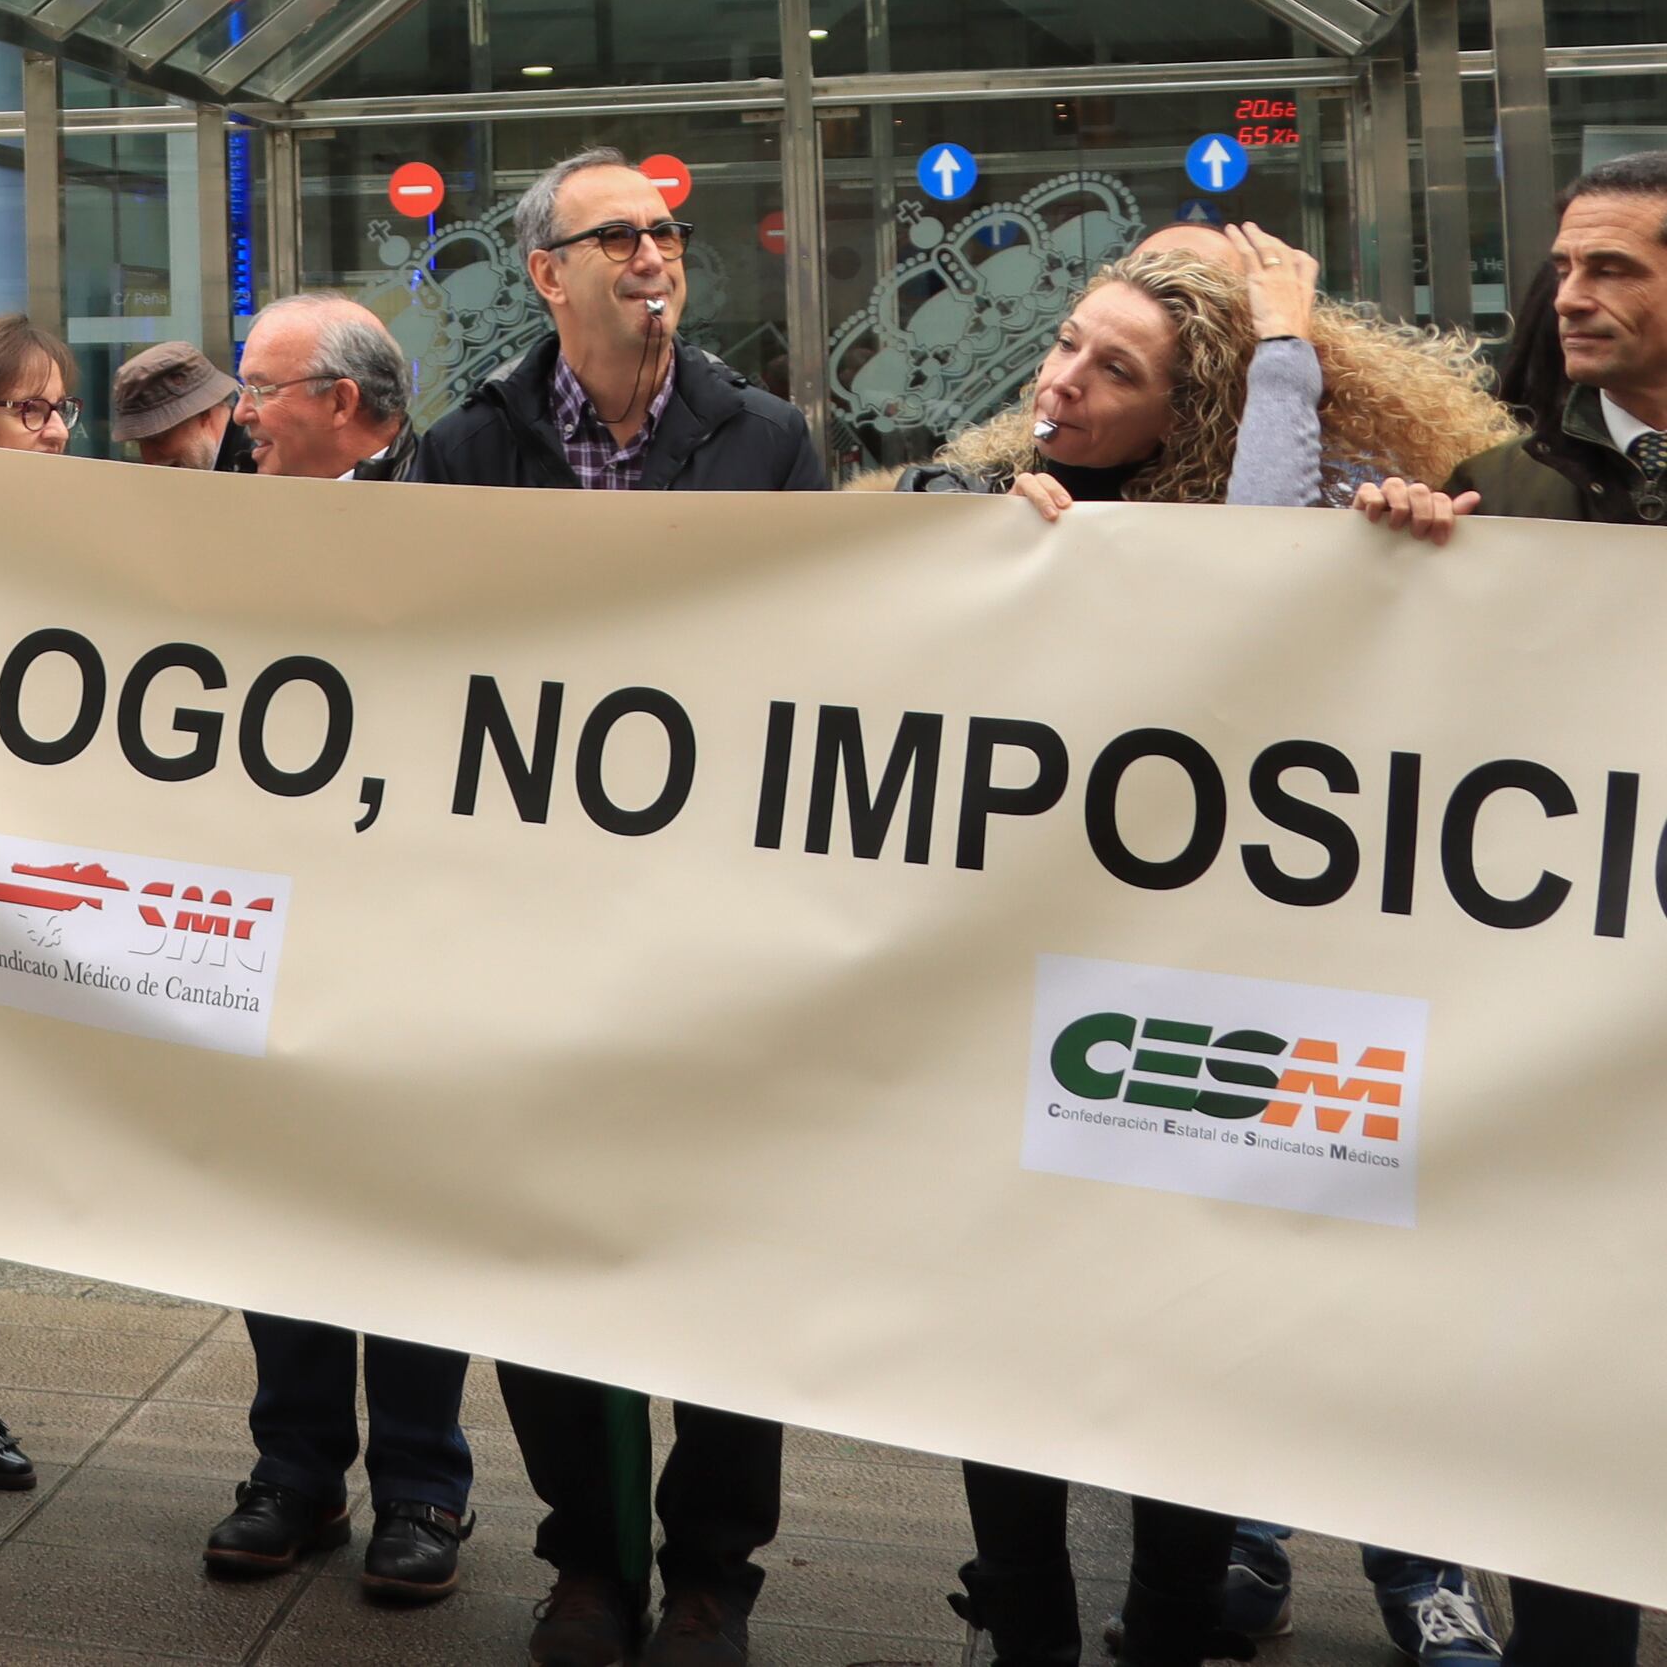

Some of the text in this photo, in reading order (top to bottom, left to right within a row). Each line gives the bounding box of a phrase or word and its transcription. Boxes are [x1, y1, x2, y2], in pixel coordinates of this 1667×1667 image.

[451, 673, 697, 837] NO
[754, 699, 1667, 939] IMPOSICI
[63, 958, 131, 993] Médico
[136, 971, 160, 998] de
[165, 975, 261, 1013] Cantabria
[1050, 1011, 1407, 1142] CESM
[1047, 1102, 1401, 1170] Confederación Estatal de Sindicatos Médicos
